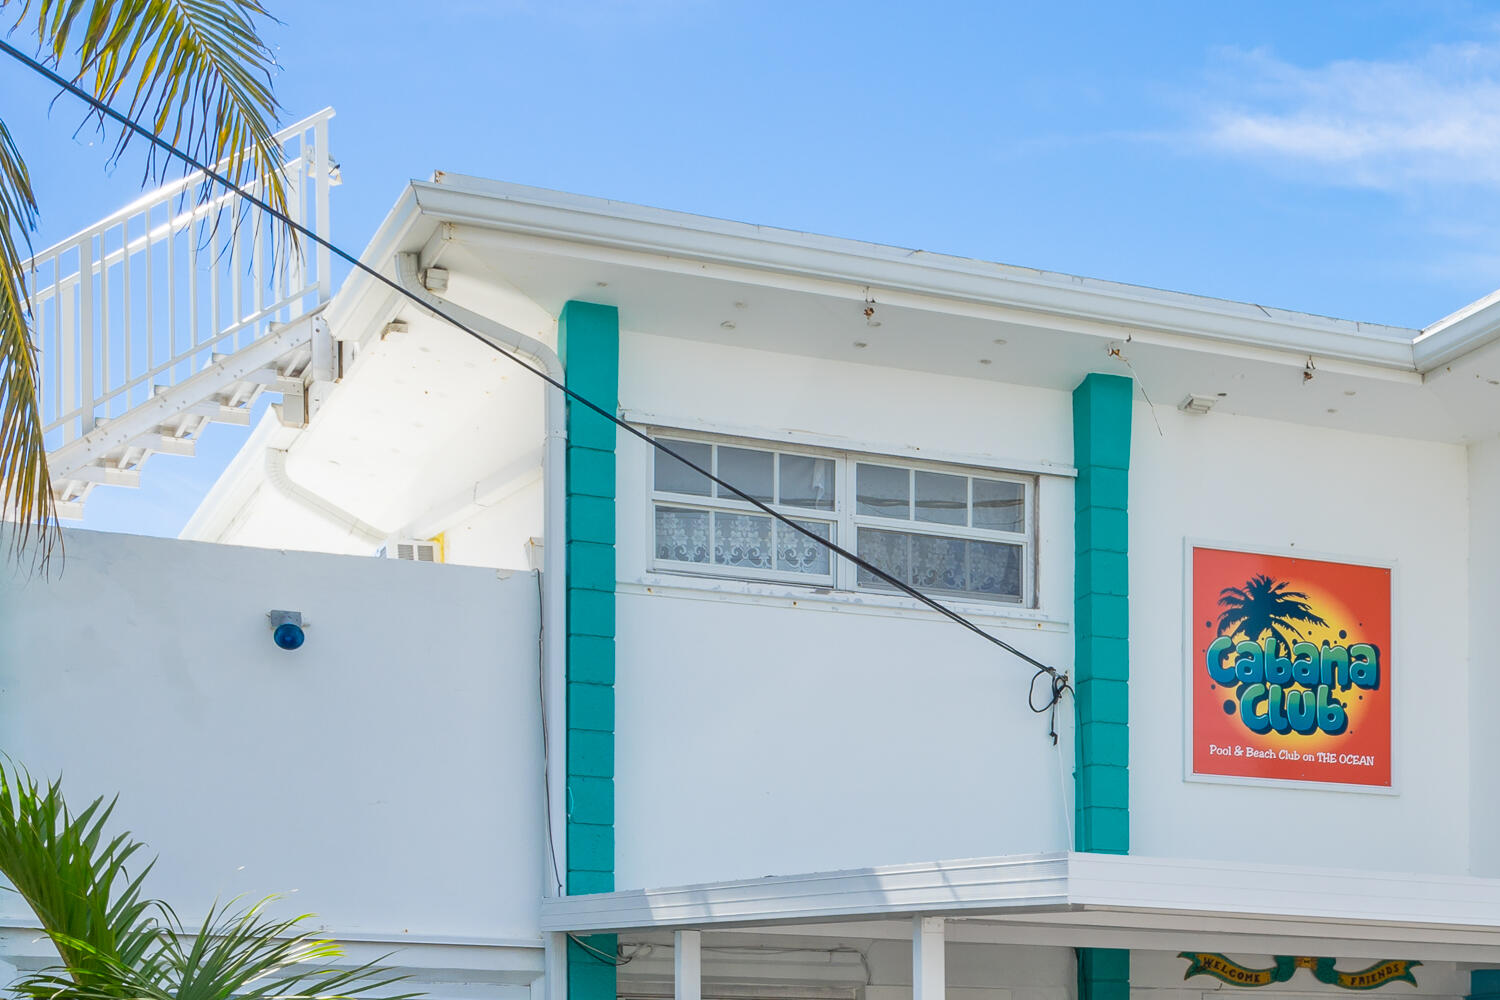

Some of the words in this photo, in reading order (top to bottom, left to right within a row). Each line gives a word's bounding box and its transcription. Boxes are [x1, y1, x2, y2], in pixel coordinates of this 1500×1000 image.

[1206, 635, 1380, 690] Cabana
[1238, 683, 1348, 735] Club
[1209, 744, 1232, 755] Pool
[1234, 745, 1244, 757] &
[1246, 747, 1276, 759] Beach
[1278, 750, 1300, 761] Club
[1303, 753, 1315, 762] on
[1317, 752, 1337, 764] THE
[1339, 754, 1374, 766] OCEAN
[1203, 957, 1260, 983] WELCOME
[1350, 963, 1400, 986] FRIENDS
